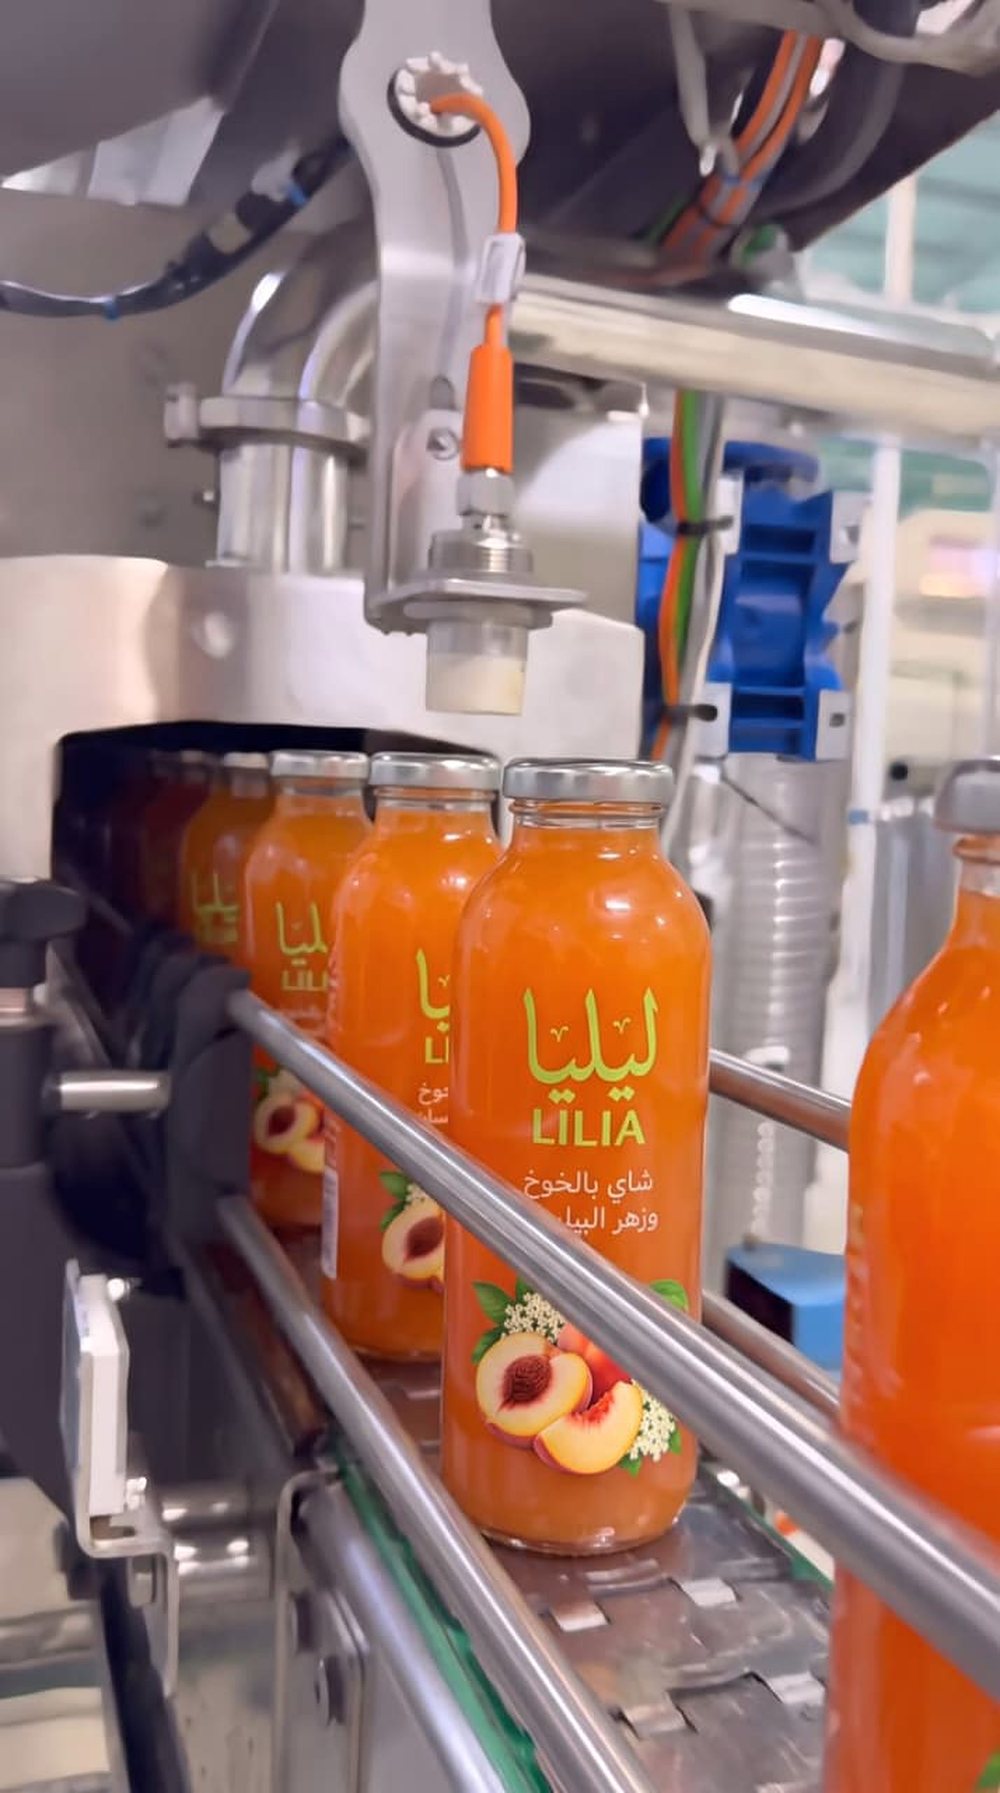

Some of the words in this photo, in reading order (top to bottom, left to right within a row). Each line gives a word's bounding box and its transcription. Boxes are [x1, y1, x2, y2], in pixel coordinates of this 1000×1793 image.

[523, 986, 659, 1104] ليليا
[532, 1108, 646, 1147] LILIA
[523, 1168, 600, 1201] بالخوخ
[607, 1168, 654, 1205] شاي
[559, 1205, 606, 1236] البيل
[611, 1206, 659, 1236] وزهر
